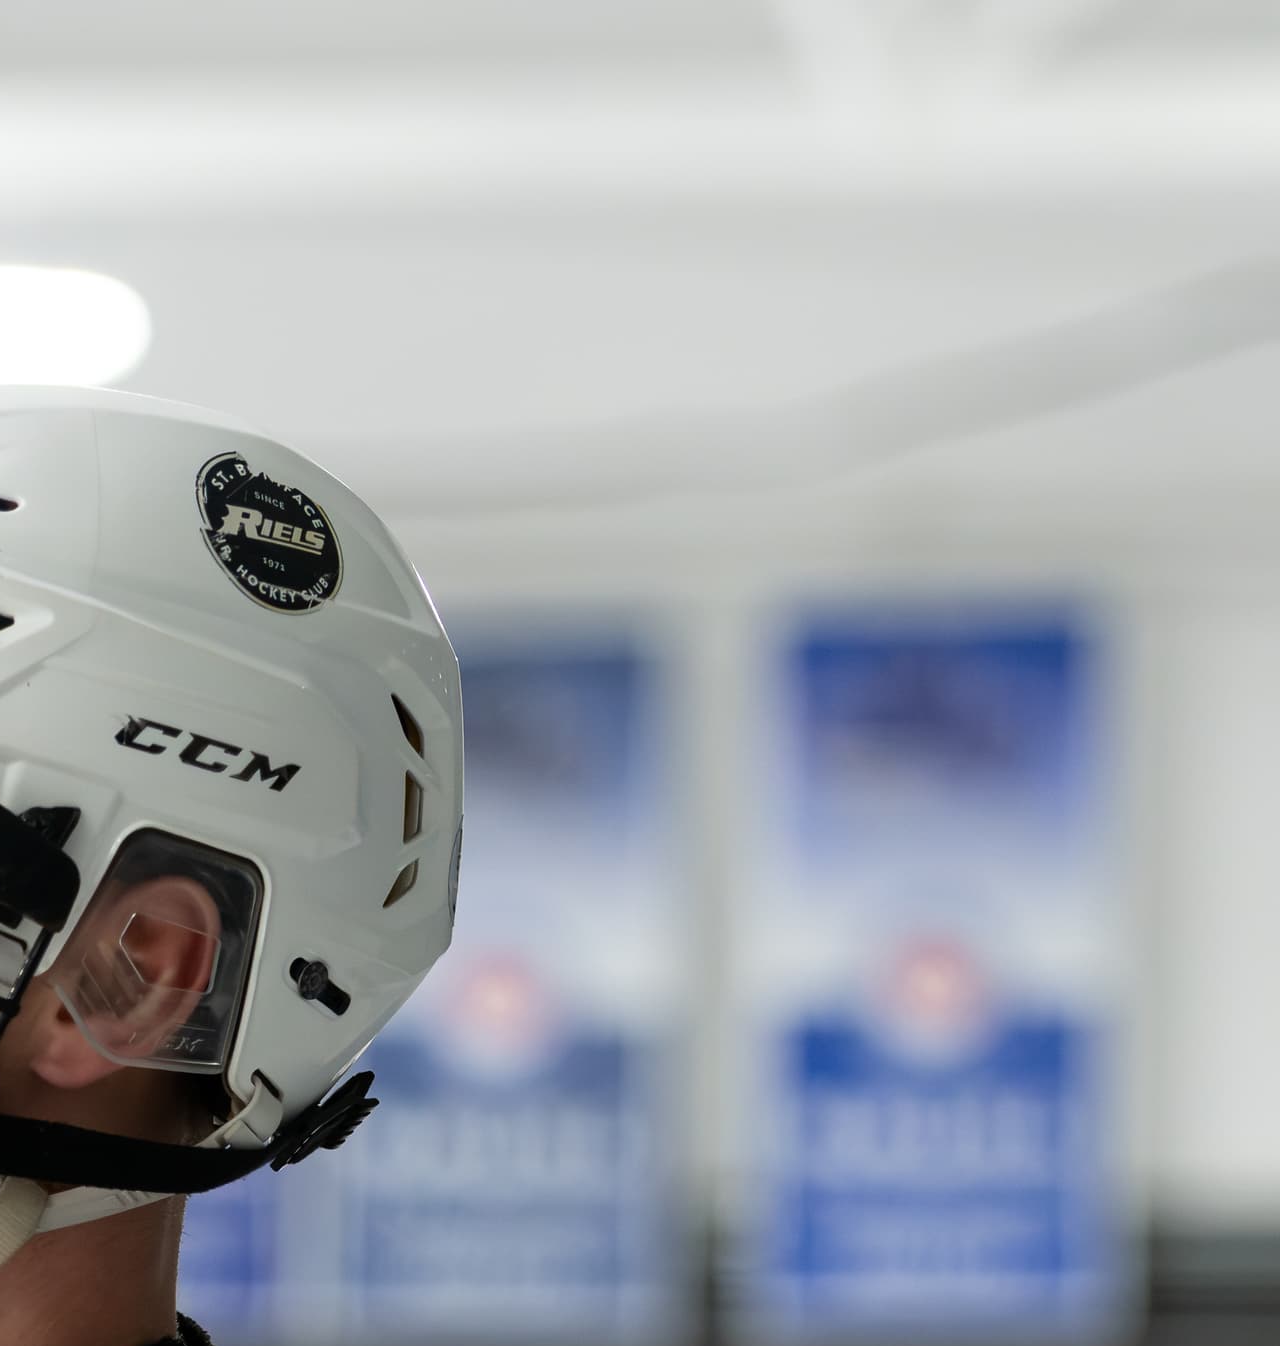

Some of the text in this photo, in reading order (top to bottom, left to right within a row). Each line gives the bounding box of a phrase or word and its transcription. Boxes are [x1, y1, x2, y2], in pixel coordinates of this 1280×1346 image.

[211, 463, 324, 529] ST. BACE
[254, 491, 286, 511] SINCE
[216, 503, 327, 556] RIELS
[236, 564, 297, 604] HOCKEY
[262, 556, 286, 572] 1971
[113, 713, 303, 793] CCM
